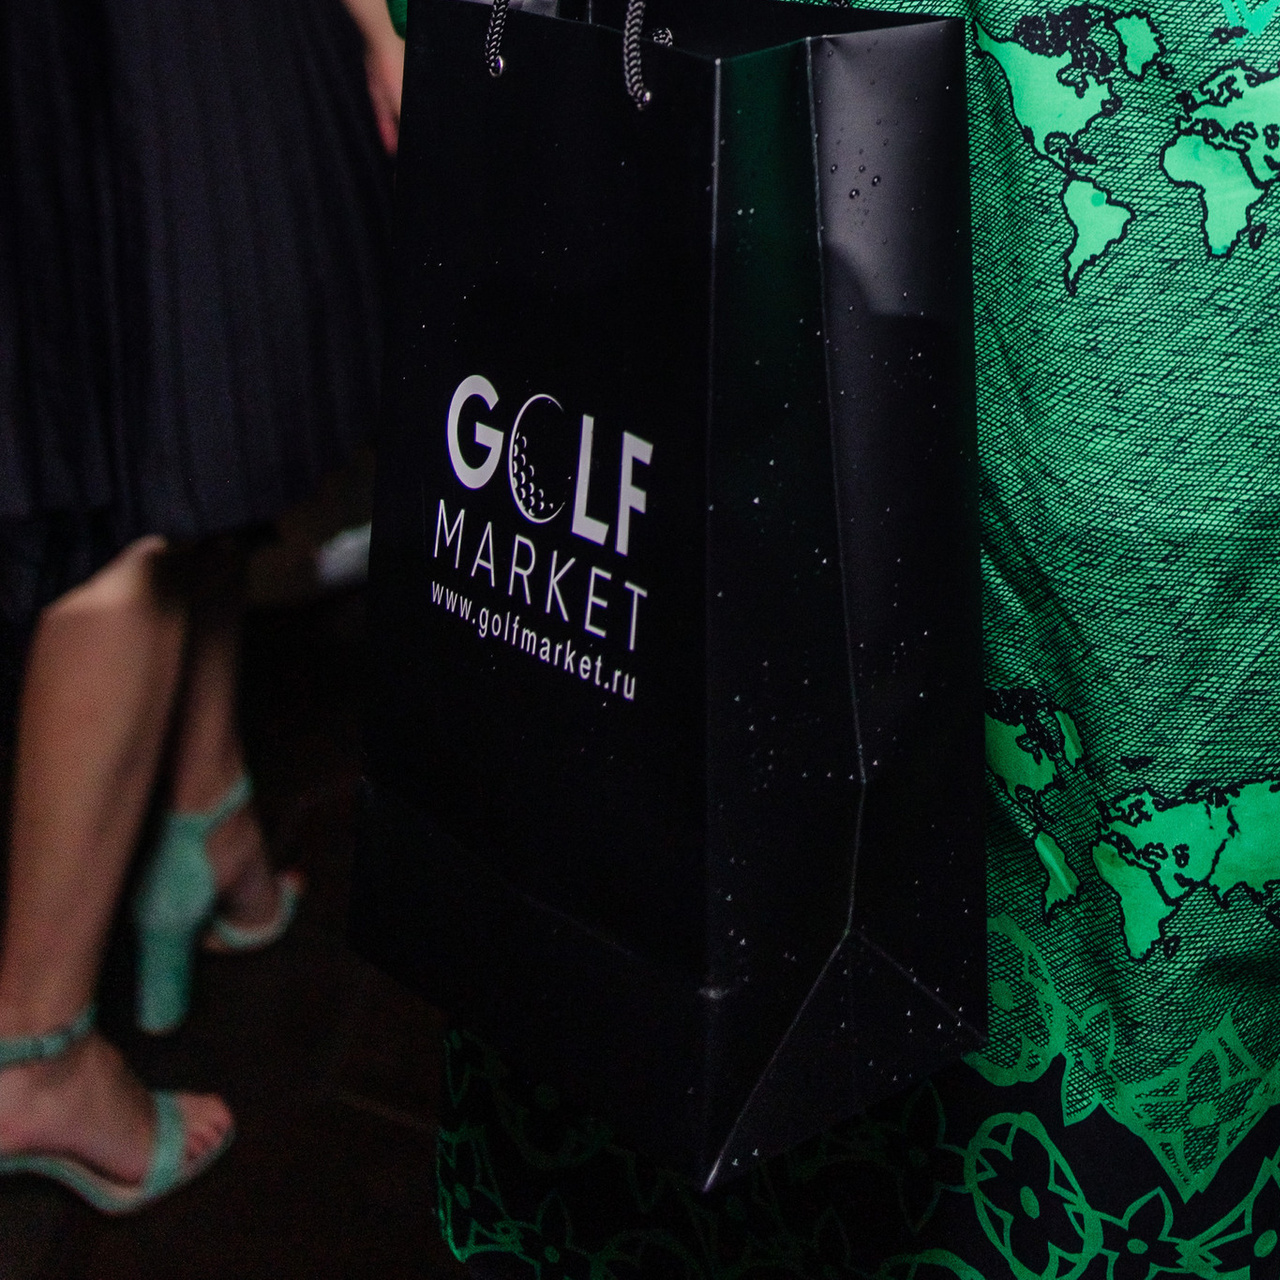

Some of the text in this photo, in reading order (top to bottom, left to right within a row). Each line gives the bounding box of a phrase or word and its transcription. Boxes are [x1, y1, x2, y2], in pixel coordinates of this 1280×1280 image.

[446, 374, 655, 557] GOLF
[431, 580, 637, 702] www.golfmarket.ru
[433, 498, 649, 651] MARKET
